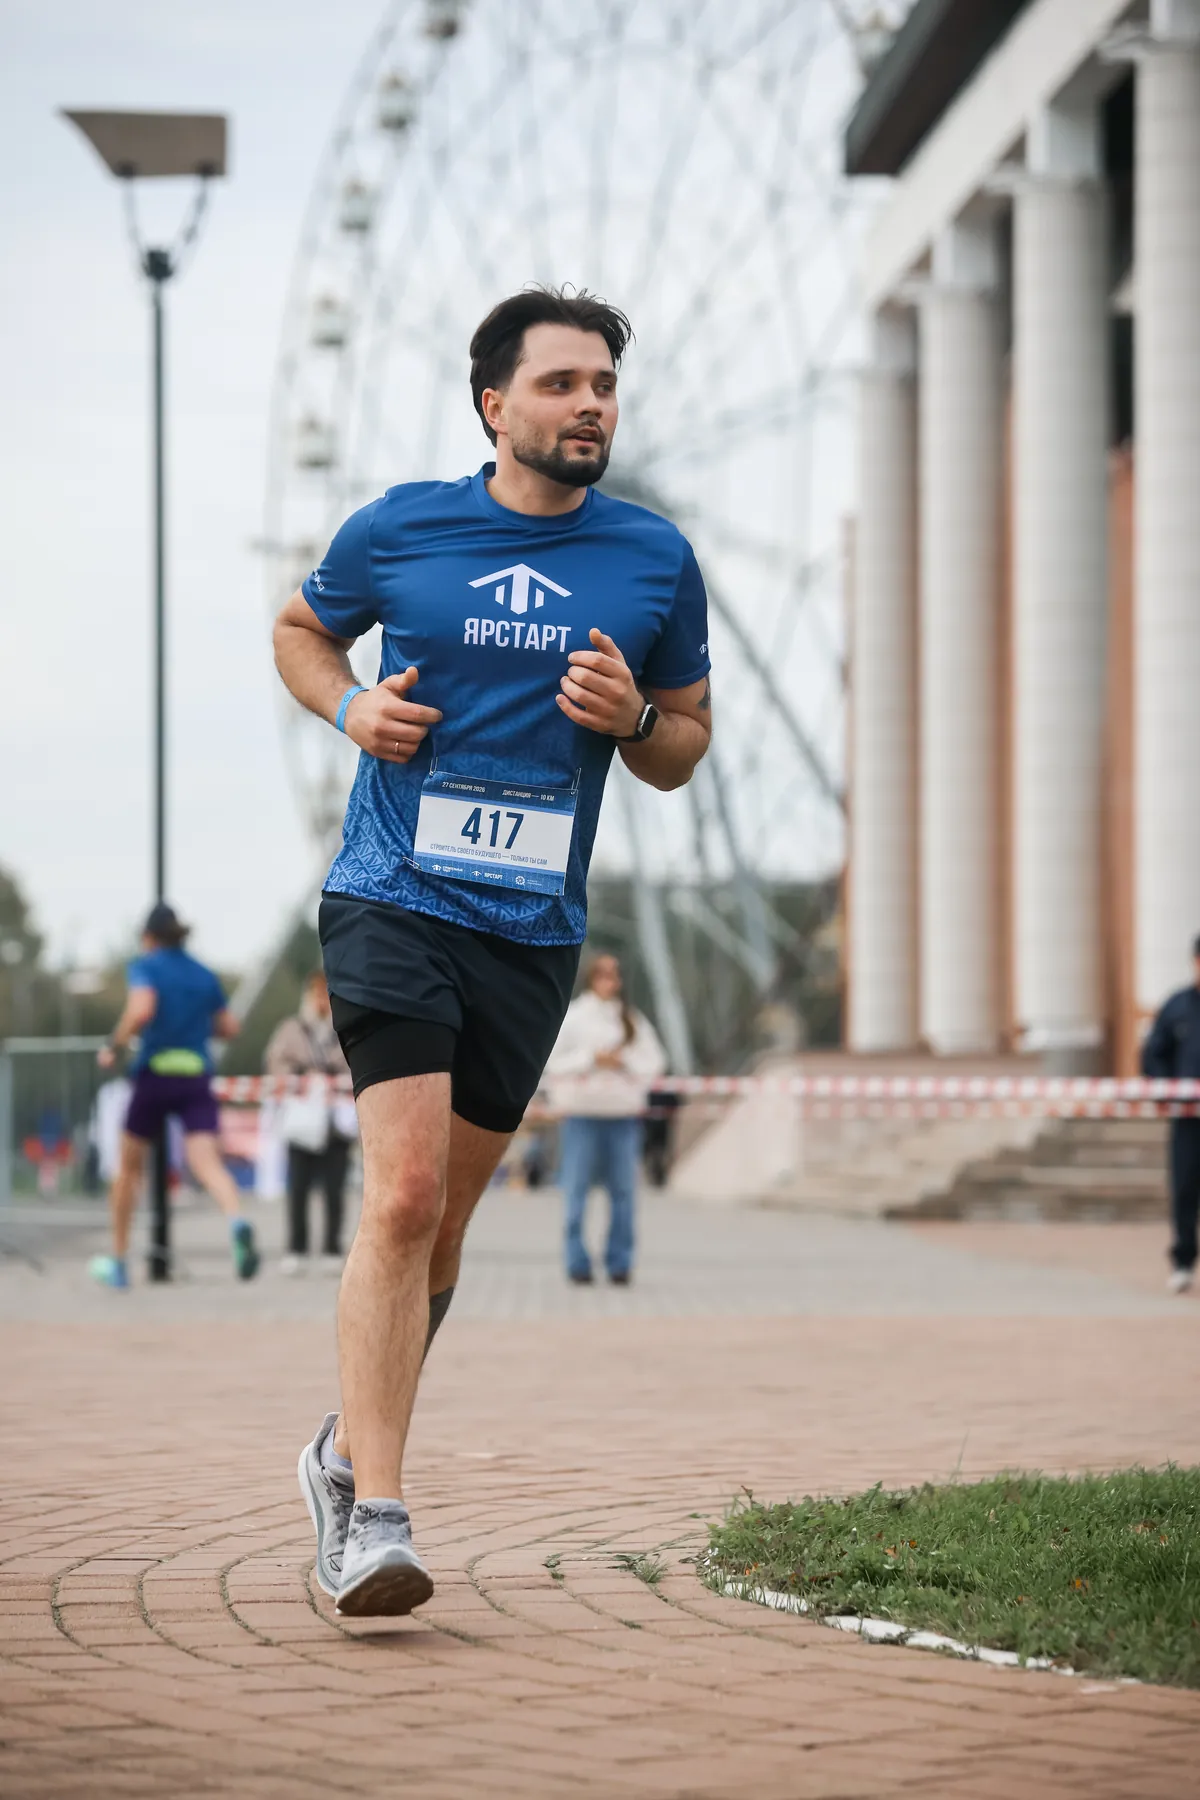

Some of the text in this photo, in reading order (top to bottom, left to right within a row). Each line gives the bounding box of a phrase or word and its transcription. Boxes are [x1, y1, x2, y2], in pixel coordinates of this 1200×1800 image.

[463, 617, 572, 652] ЯРСТАРТ
[449, 782, 473, 791] СЕНТЯБРЯ
[502, 789, 531, 799] ДИСТАНЦИЯ
[461, 807, 525, 850] 417
[429, 843, 457, 853] СТРОИТЕЛЬ
[456, 847, 475, 855] СВОЕГО
[474, 849, 502, 858] БУДУЩЕГО
[510, 854, 529, 863] ТОЛЬКО
[484, 872, 503, 880] ЯРСТАРТ
